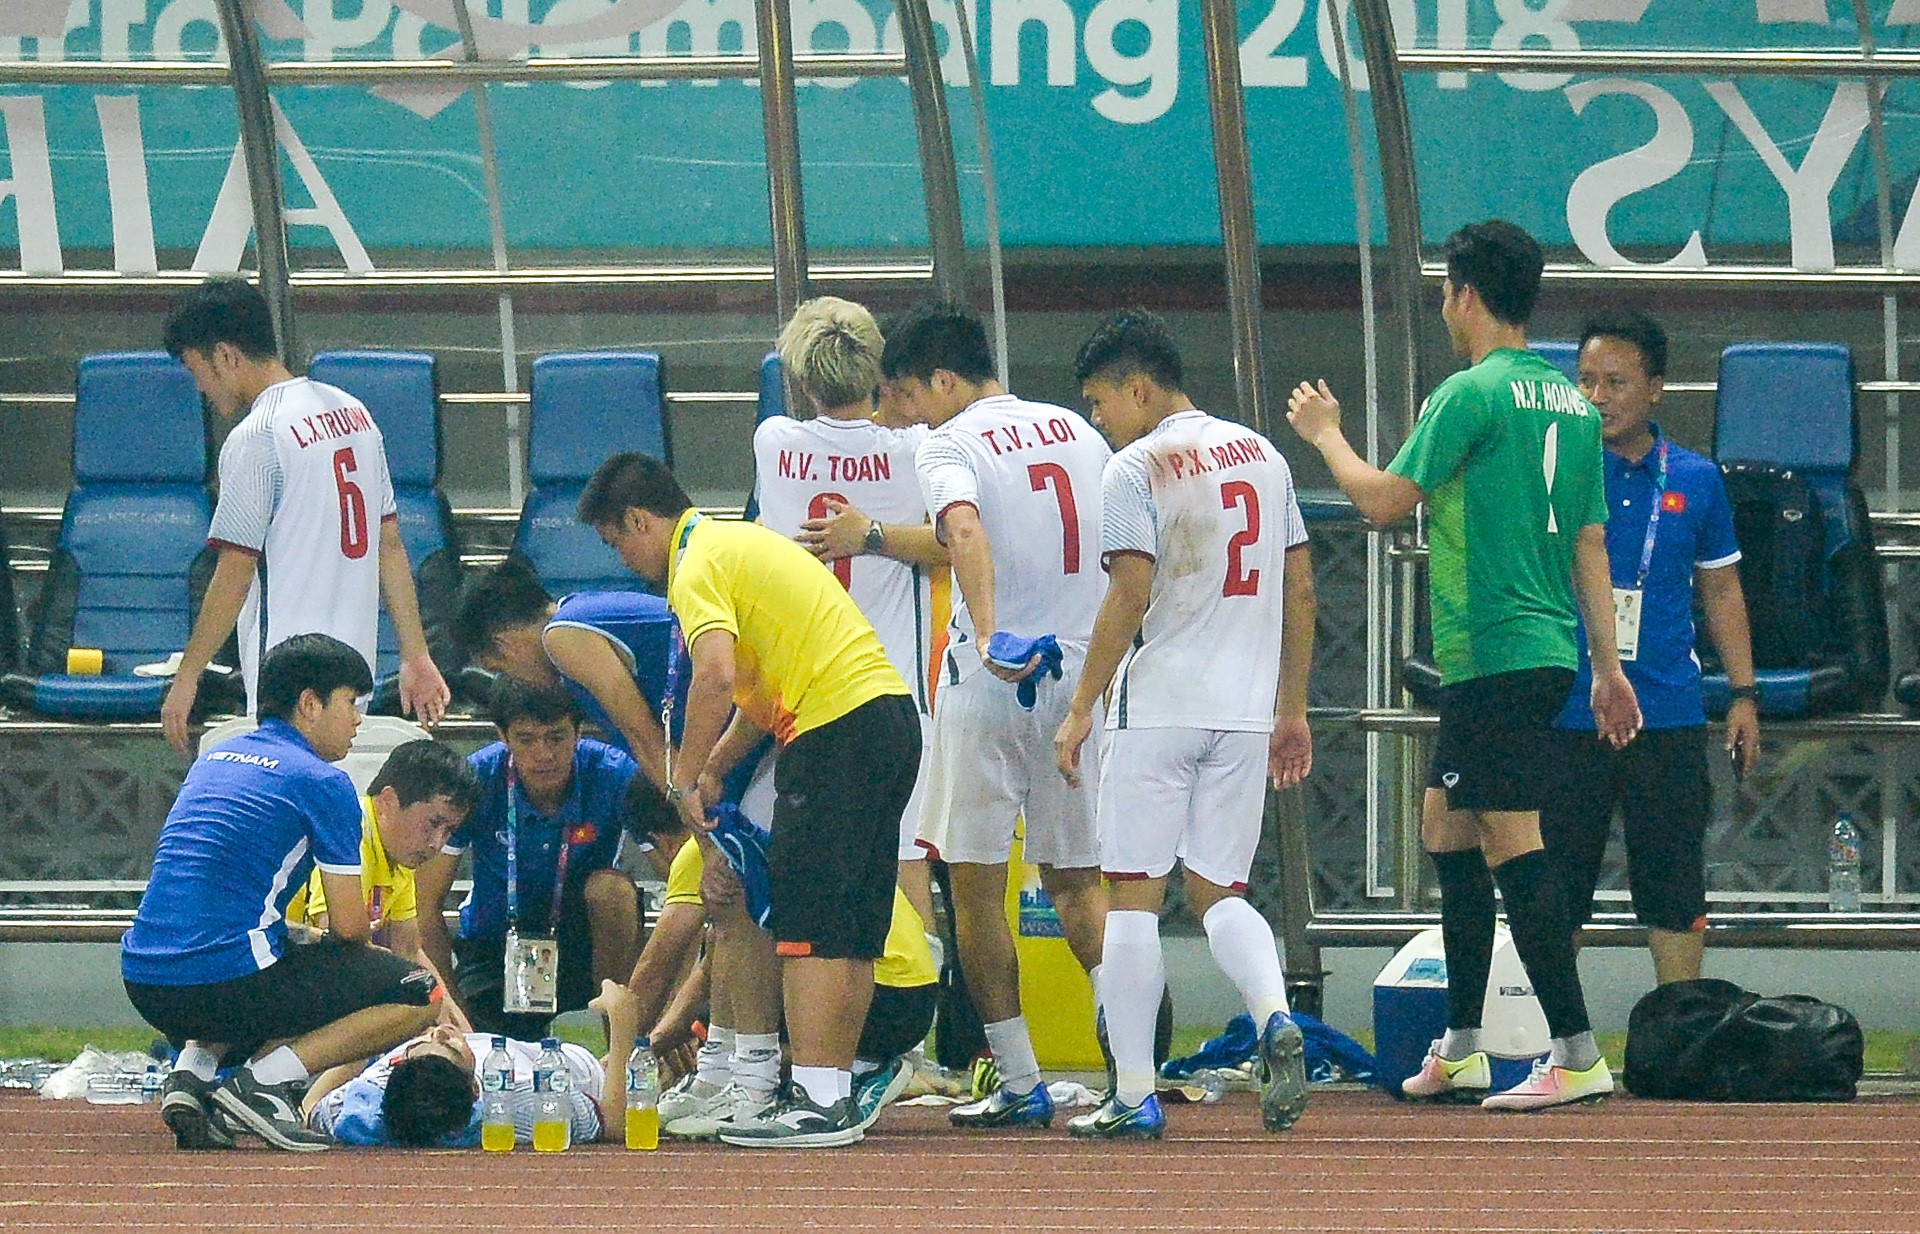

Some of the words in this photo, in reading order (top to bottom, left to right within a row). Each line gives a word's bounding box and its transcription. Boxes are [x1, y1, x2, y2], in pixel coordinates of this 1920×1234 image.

[1510, 379, 1541, 410] N.V.
[981, 425, 1032, 456] T.V.
[1033, 417, 1077, 447] LOI
[778, 449, 818, 481] N.V.
[827, 452, 891, 482] TOAN
[1167, 448, 1212, 480] P.X.
[1209, 437, 1267, 471] MANH
[1542, 421, 1559, 534] 1
[333, 446, 369, 560] 6
[1026, 461, 1081, 576] 7
[1219, 479, 1261, 598] 2
[205, 750, 281, 770] VIETNAM
